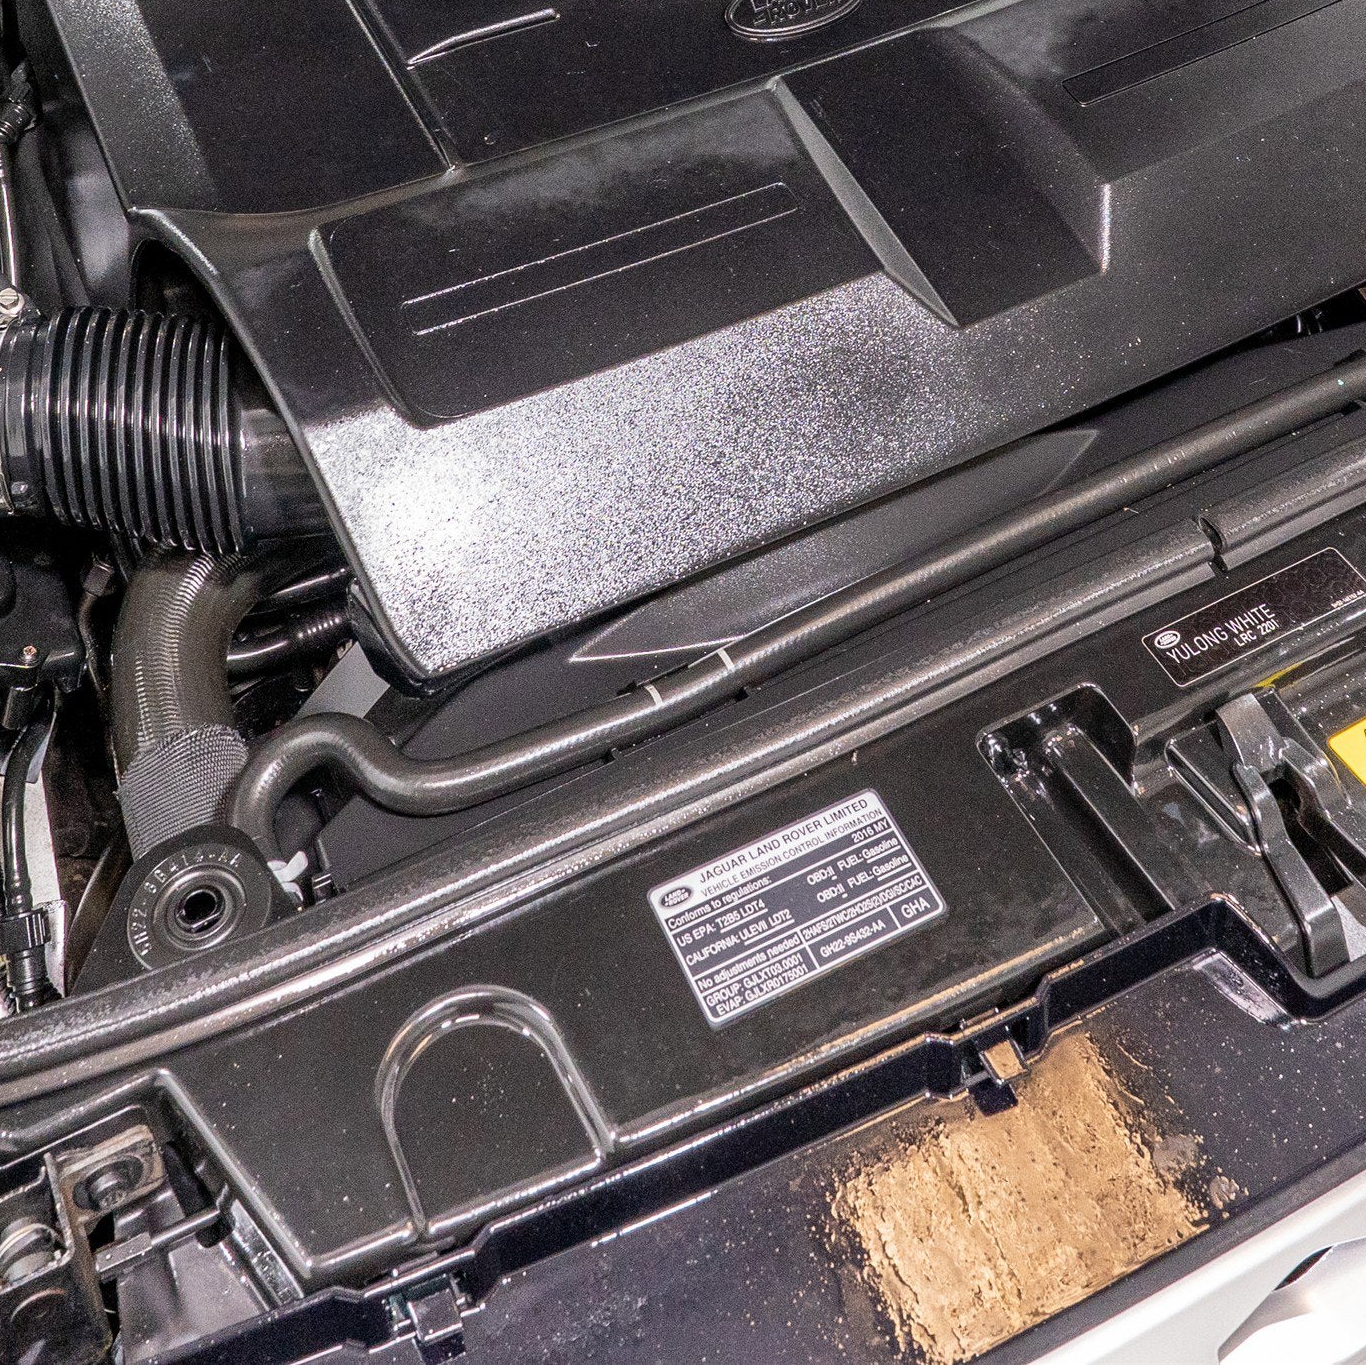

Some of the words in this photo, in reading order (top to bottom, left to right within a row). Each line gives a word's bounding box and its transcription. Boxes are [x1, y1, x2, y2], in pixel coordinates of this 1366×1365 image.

[1166, 626, 1229, 664] YULONG
[1225, 603, 1276, 634] WHITE
[1234, 630, 1257, 647] LRC
[1260, 619, 1281, 636] 2201
[699, 854, 748, 884] JAGUAR
[748, 839, 781, 864] LAND
[783, 819, 824, 848] ROVER
[824, 798, 868, 829] LIMITED
[851, 826, 875, 844] 2016
[874, 819, 890, 835] MY
[701, 874, 740, 898] VEHICLE
[741, 855, 782, 880] EMISSION
[783, 836, 824, 859] CONTROL
[825, 808, 883, 839] INFORMATION
[862, 837, 898, 859] Gasoline
[872, 853, 909, 876] Gasoline
[664, 889, 682, 902] LAND
[667, 902, 712, 930] Conforms
[711, 898, 722, 910] to
[722, 876, 772, 907] regulations:
[901, 897, 931, 919] GHA
[677, 931, 693, 947] US
[693, 923, 716, 941] EPA:
[716, 911, 741, 929] T2B5
[740, 899, 766, 917] LDT4
[686, 934, 740, 966] CALIFORNIA:
[769, 908, 793, 927] LDT2
[697, 976, 713, 991] No
[713, 951, 767, 986] adjustments
[767, 934, 800, 959] needed
[706, 983, 744, 1007] GROUP:
[716, 996, 745, 1016] EVAP:
